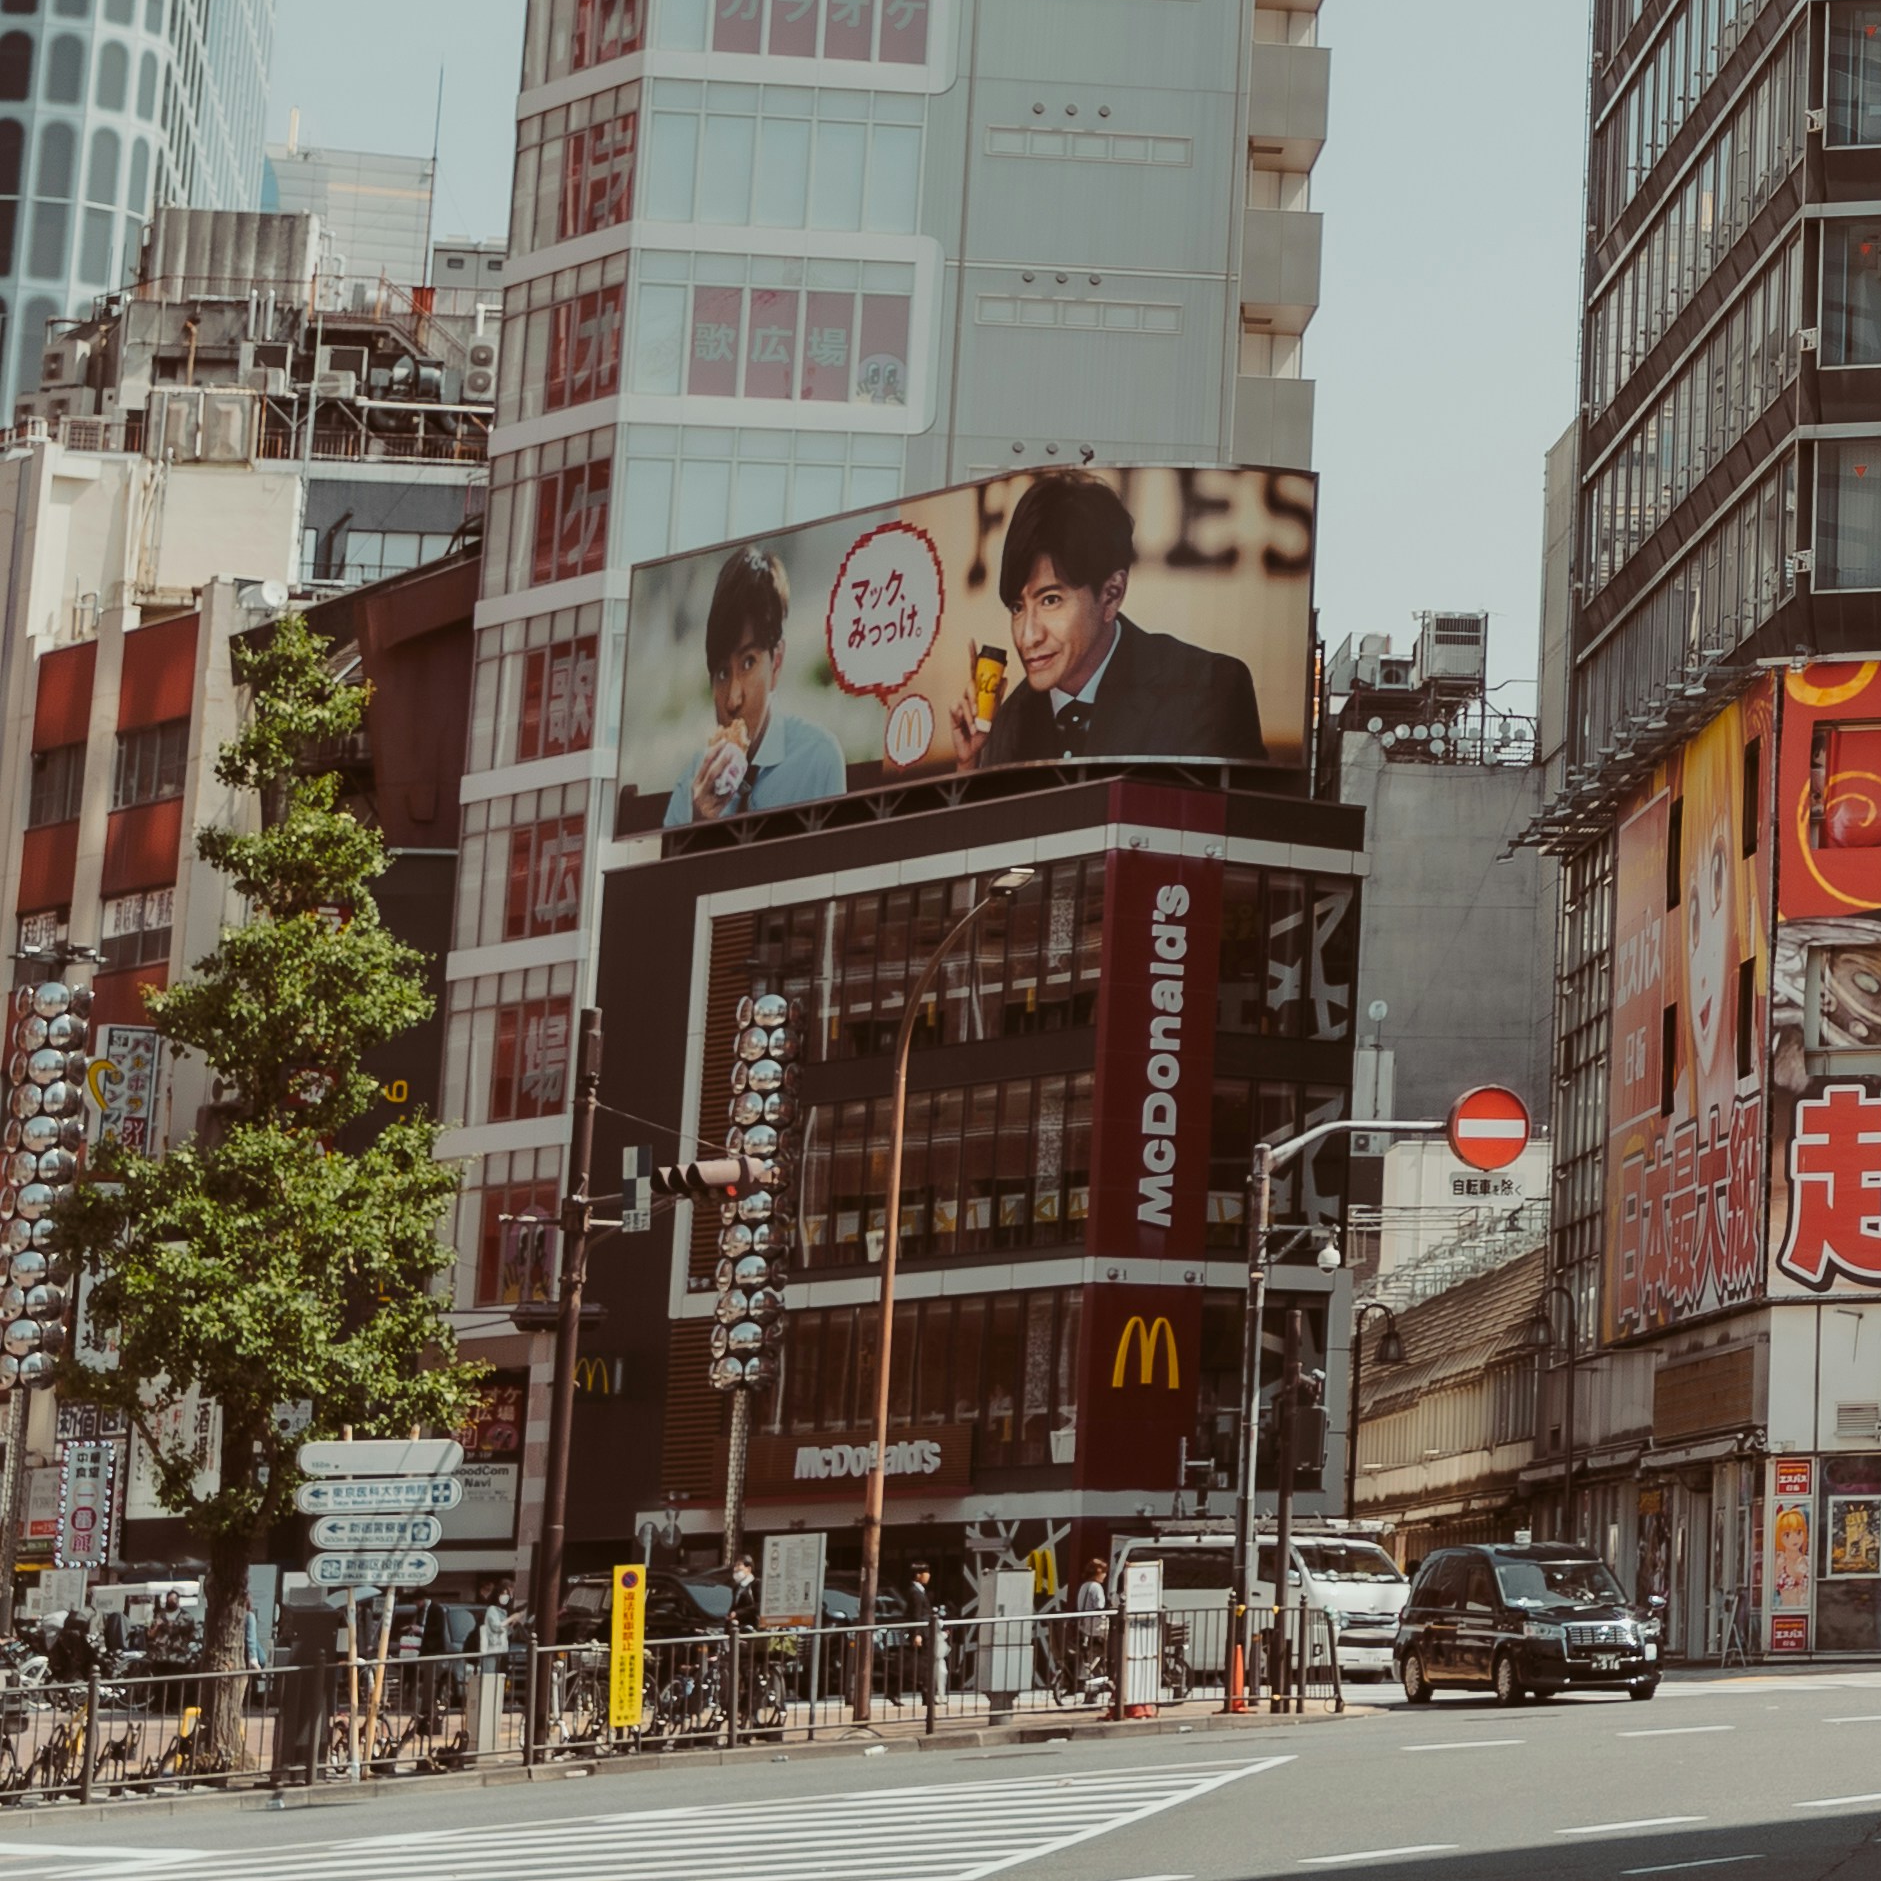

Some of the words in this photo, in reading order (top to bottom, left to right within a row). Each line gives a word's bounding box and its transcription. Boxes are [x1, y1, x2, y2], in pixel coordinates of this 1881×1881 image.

[695, 321, 850, 369] 歌広場
[848, 567, 907, 610] マック、
[1616, 907, 1663, 1011] エスパス
[1136, 883, 1190, 1227] McDonald's
[1452, 1179, 1522, 1196] 自転車を除く
[1612, 1089, 1763, 1329] 日本最大級
[464, 1478, 491, 1488] Navi
[795, 1441, 942, 1480] McDoald's
